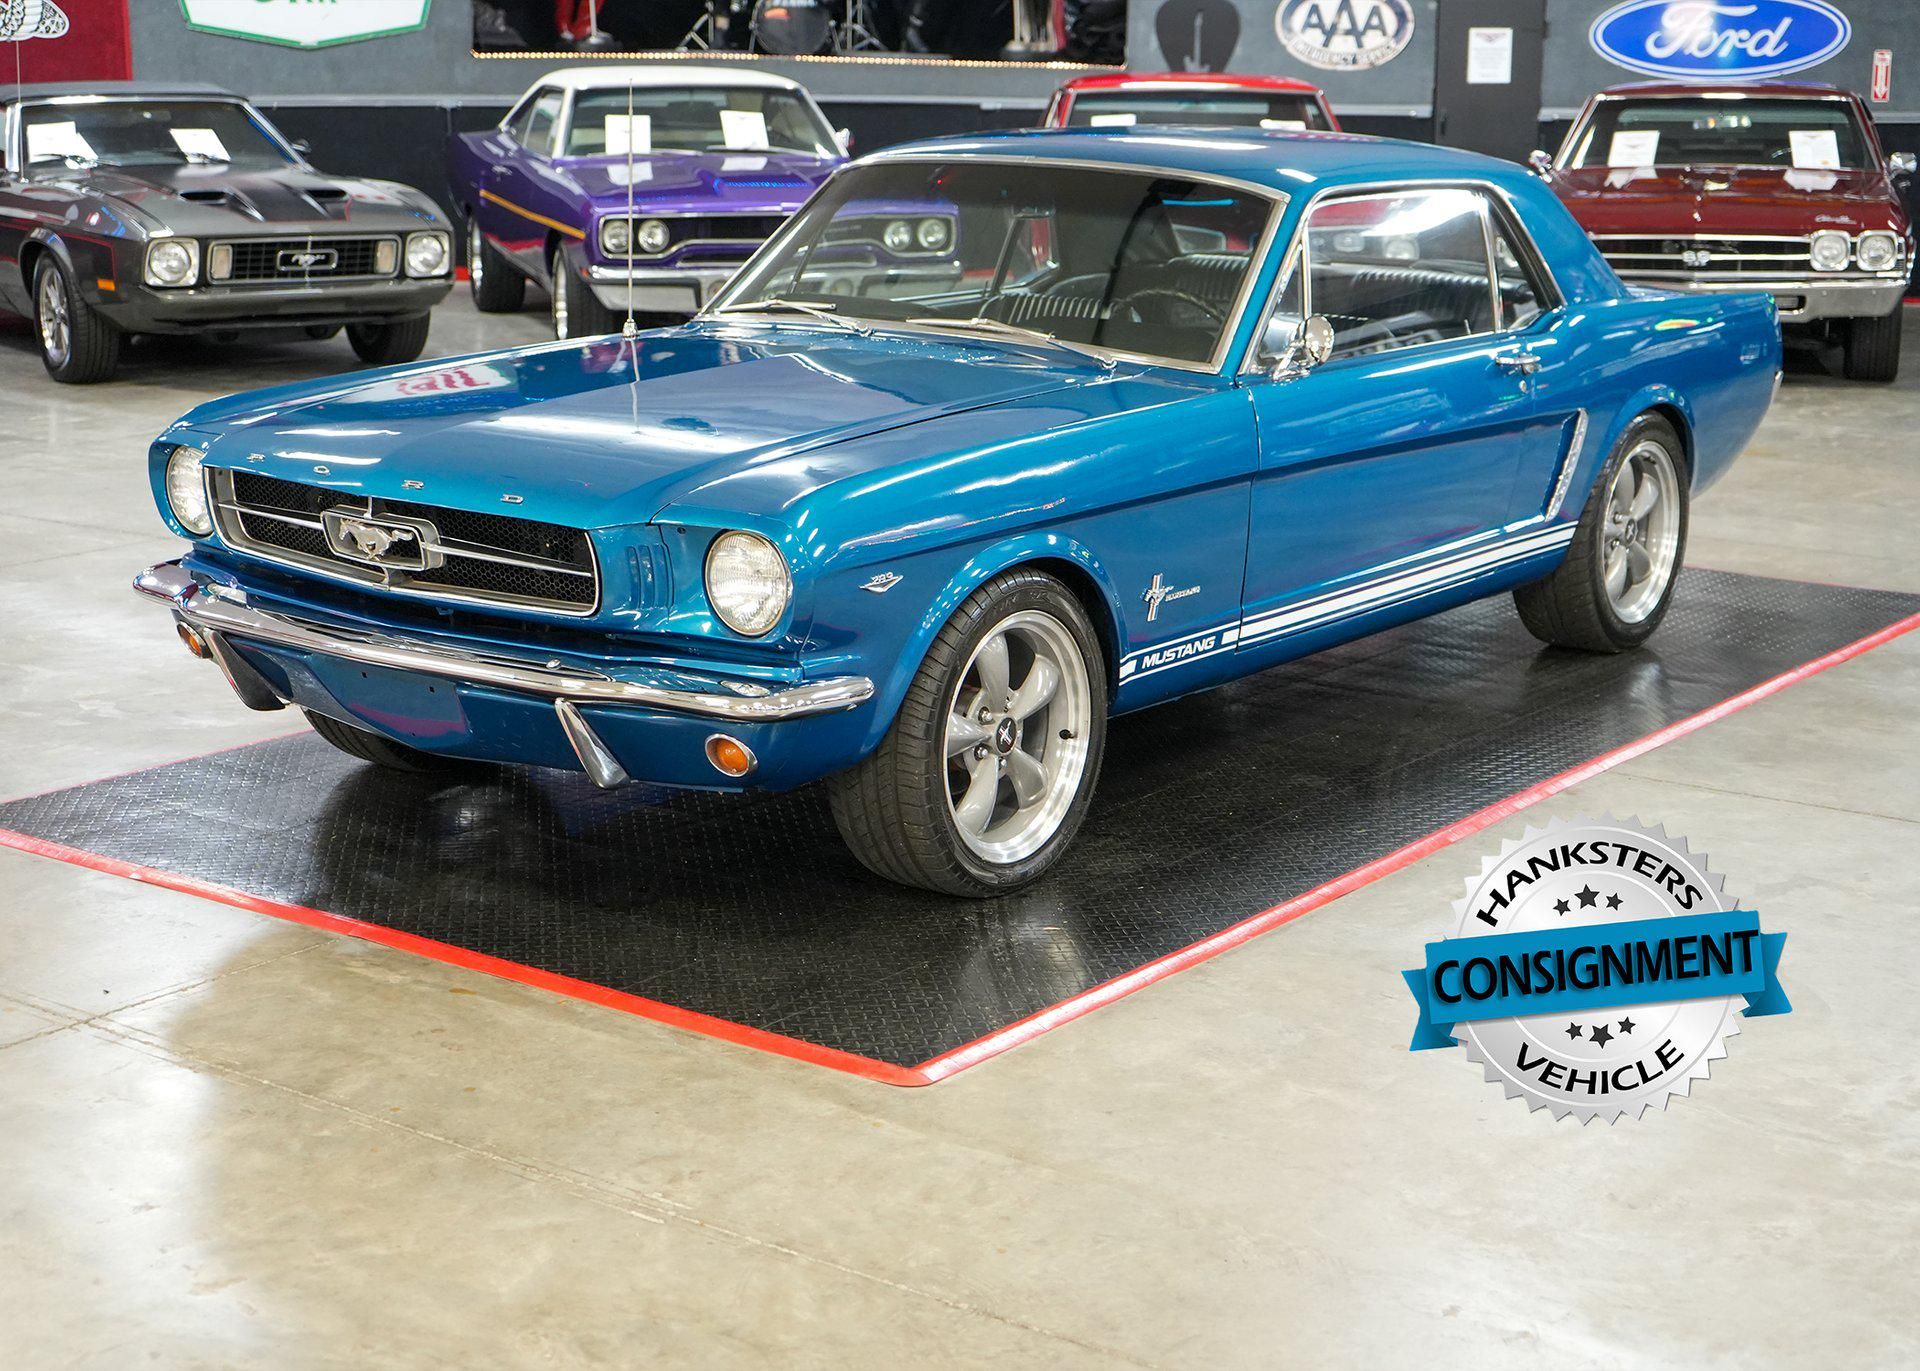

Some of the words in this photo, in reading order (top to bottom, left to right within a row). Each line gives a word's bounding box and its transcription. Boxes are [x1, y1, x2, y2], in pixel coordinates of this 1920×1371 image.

[1301, 0, 1387, 48] AAA
[1645, 1, 1793, 58] Ford
[870, 571, 894, 585] 289
[1141, 636, 1216, 669] MUSTANG
